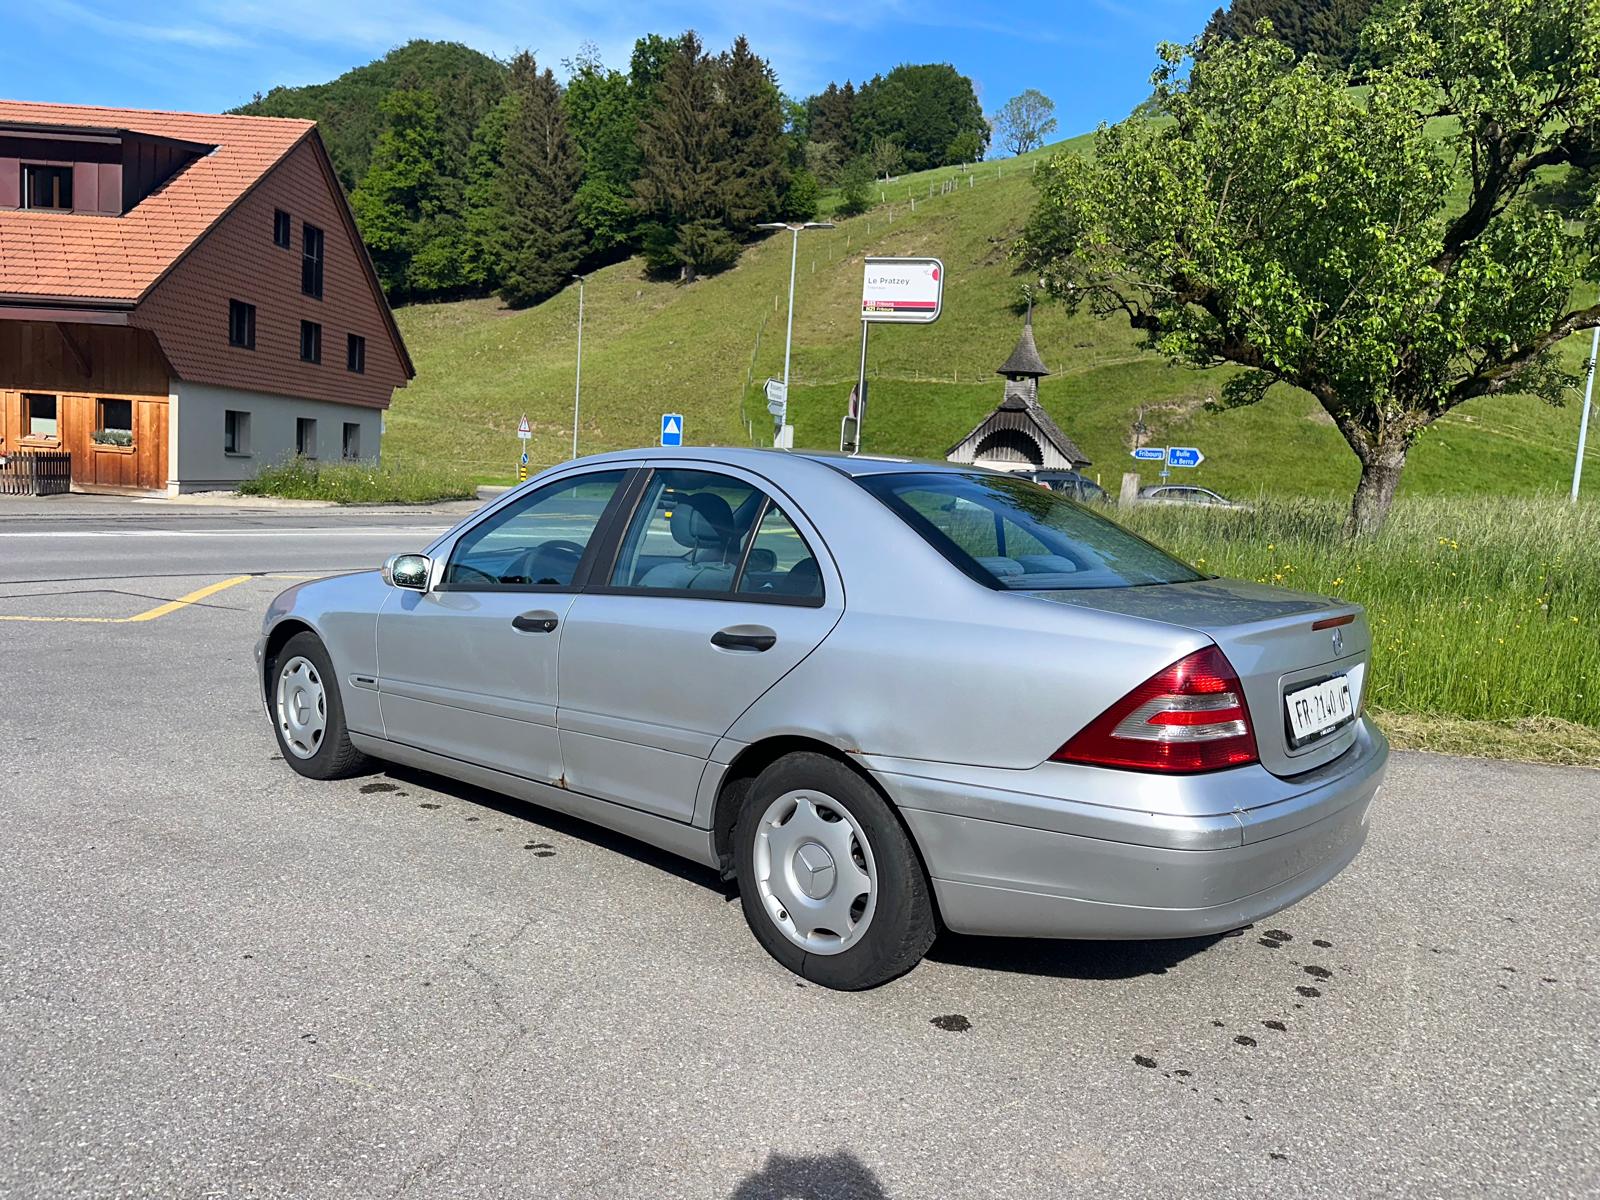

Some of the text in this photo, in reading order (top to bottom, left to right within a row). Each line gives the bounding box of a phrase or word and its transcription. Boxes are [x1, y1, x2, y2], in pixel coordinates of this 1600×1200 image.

[868, 277, 910, 286] Le Pratzey
[1138, 450, 1162, 458] Fribourg
[1295, 699, 1312, 729] FR
